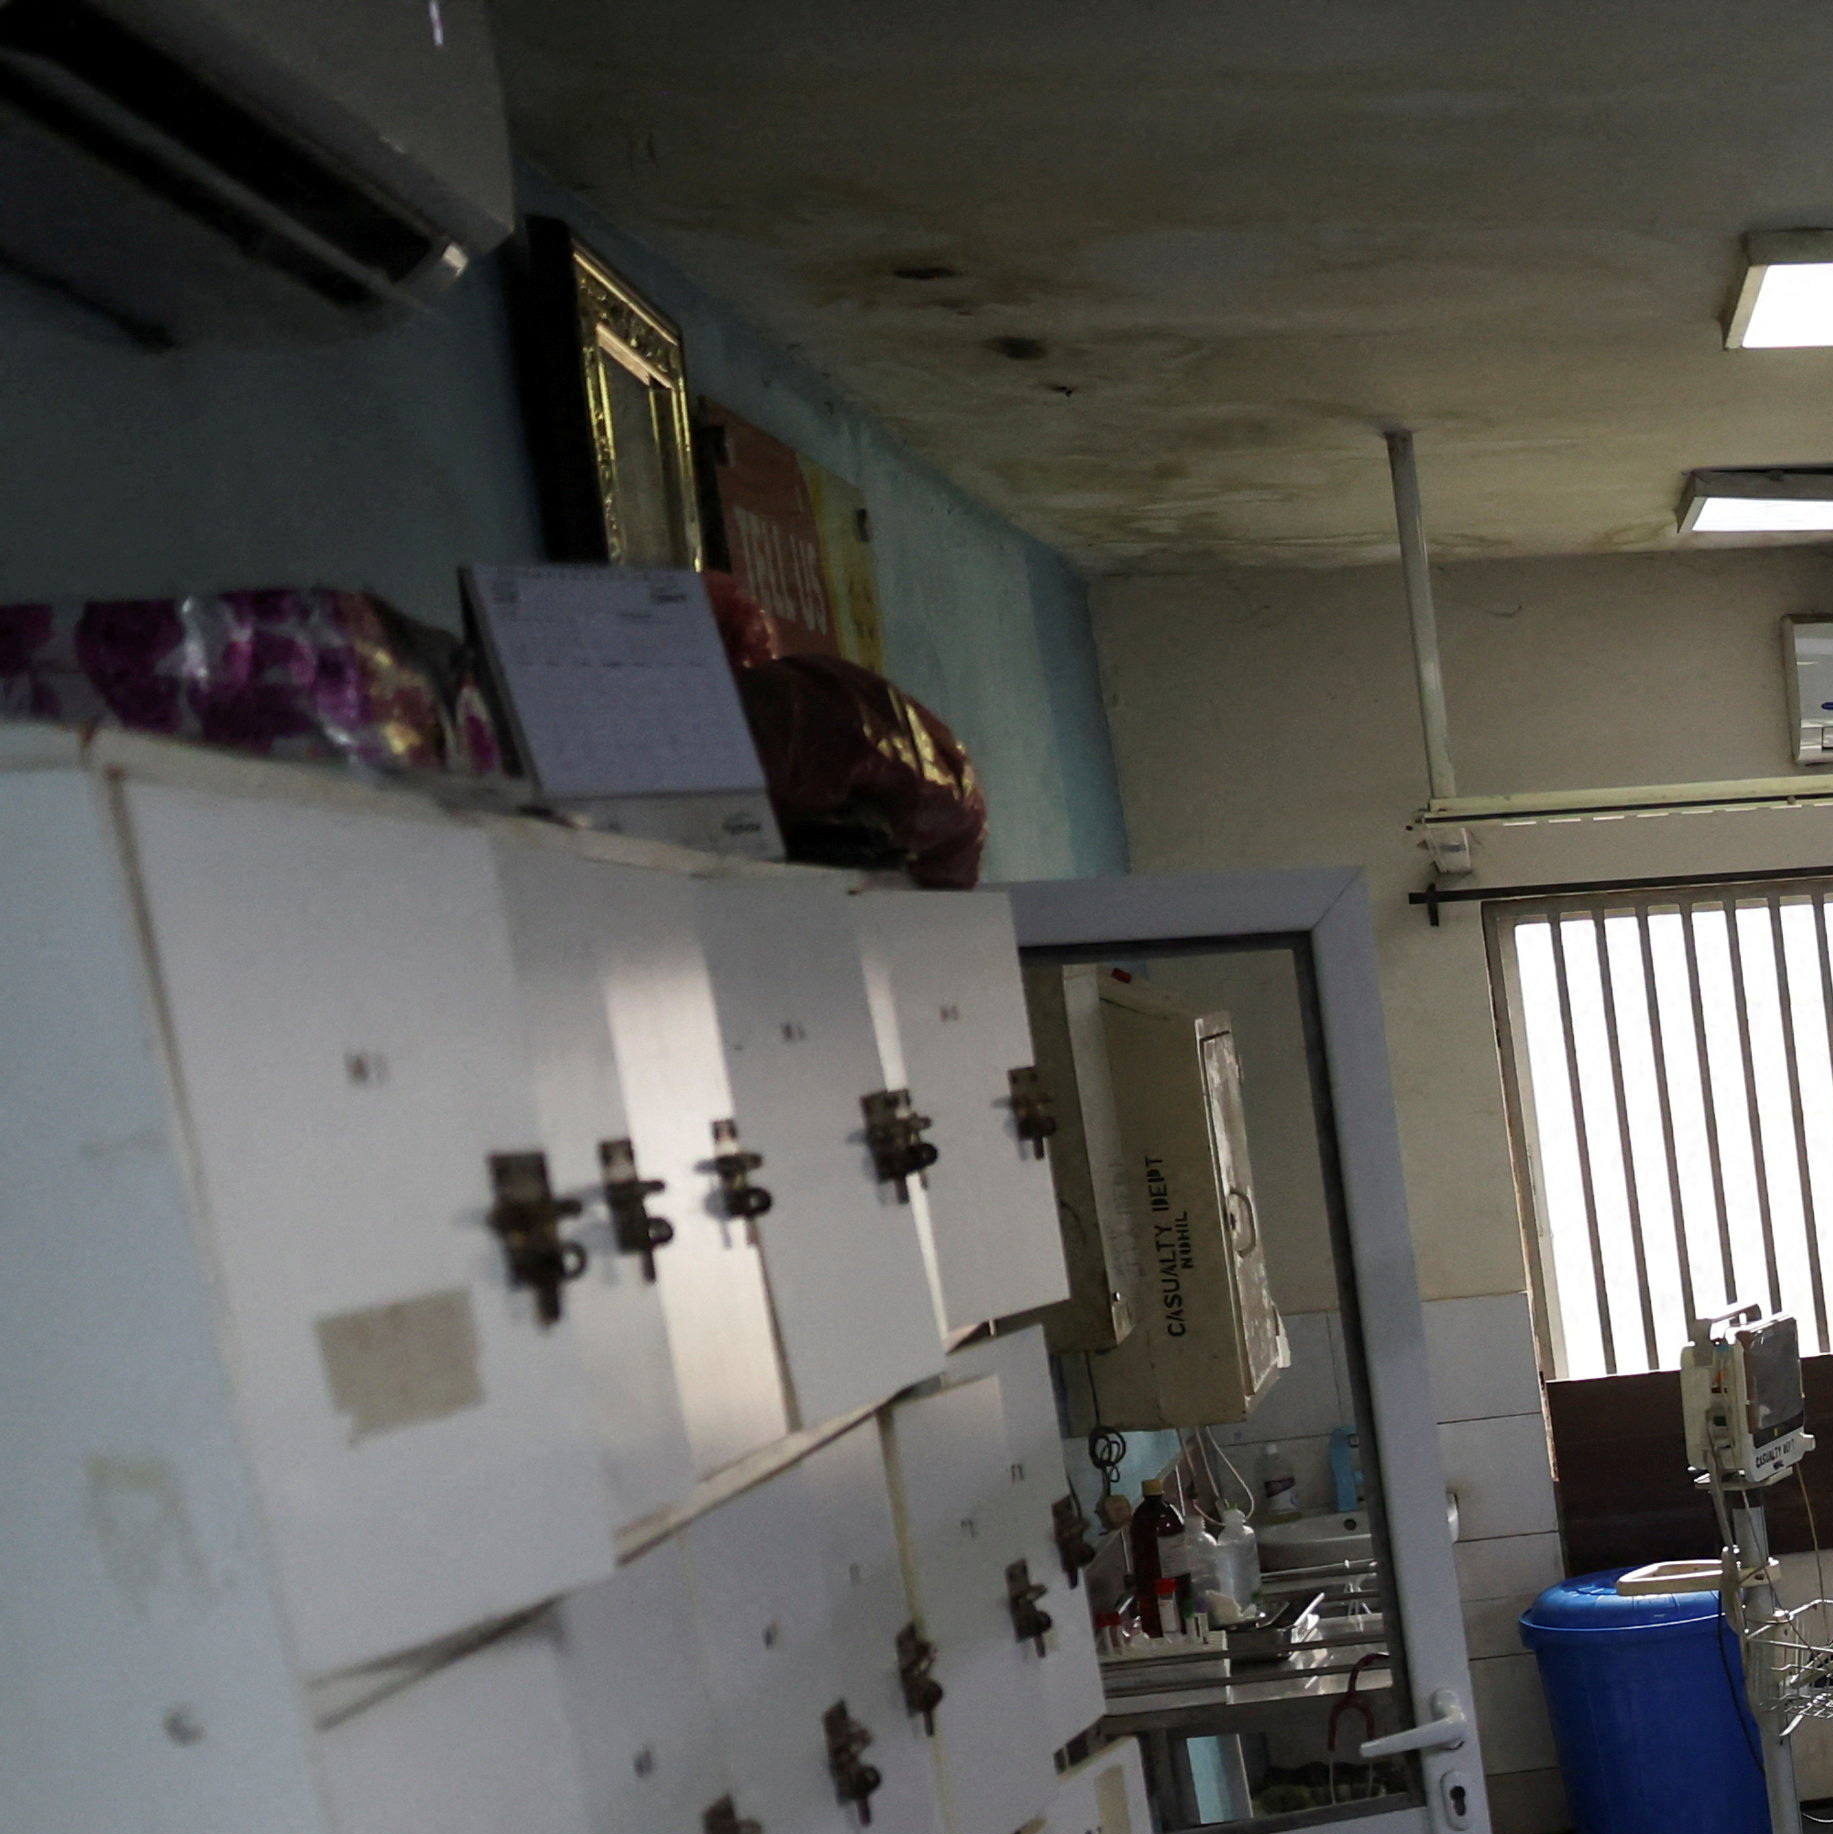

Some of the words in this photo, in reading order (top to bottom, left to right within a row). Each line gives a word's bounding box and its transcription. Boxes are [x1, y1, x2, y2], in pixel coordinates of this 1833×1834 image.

[790, 533, 828, 636] US
[1145, 1156, 1170, 1212] DEPT
[1154, 1225, 1186, 1337] CASUALTY
[1756, 1446, 1782, 1468] CASUALTY
